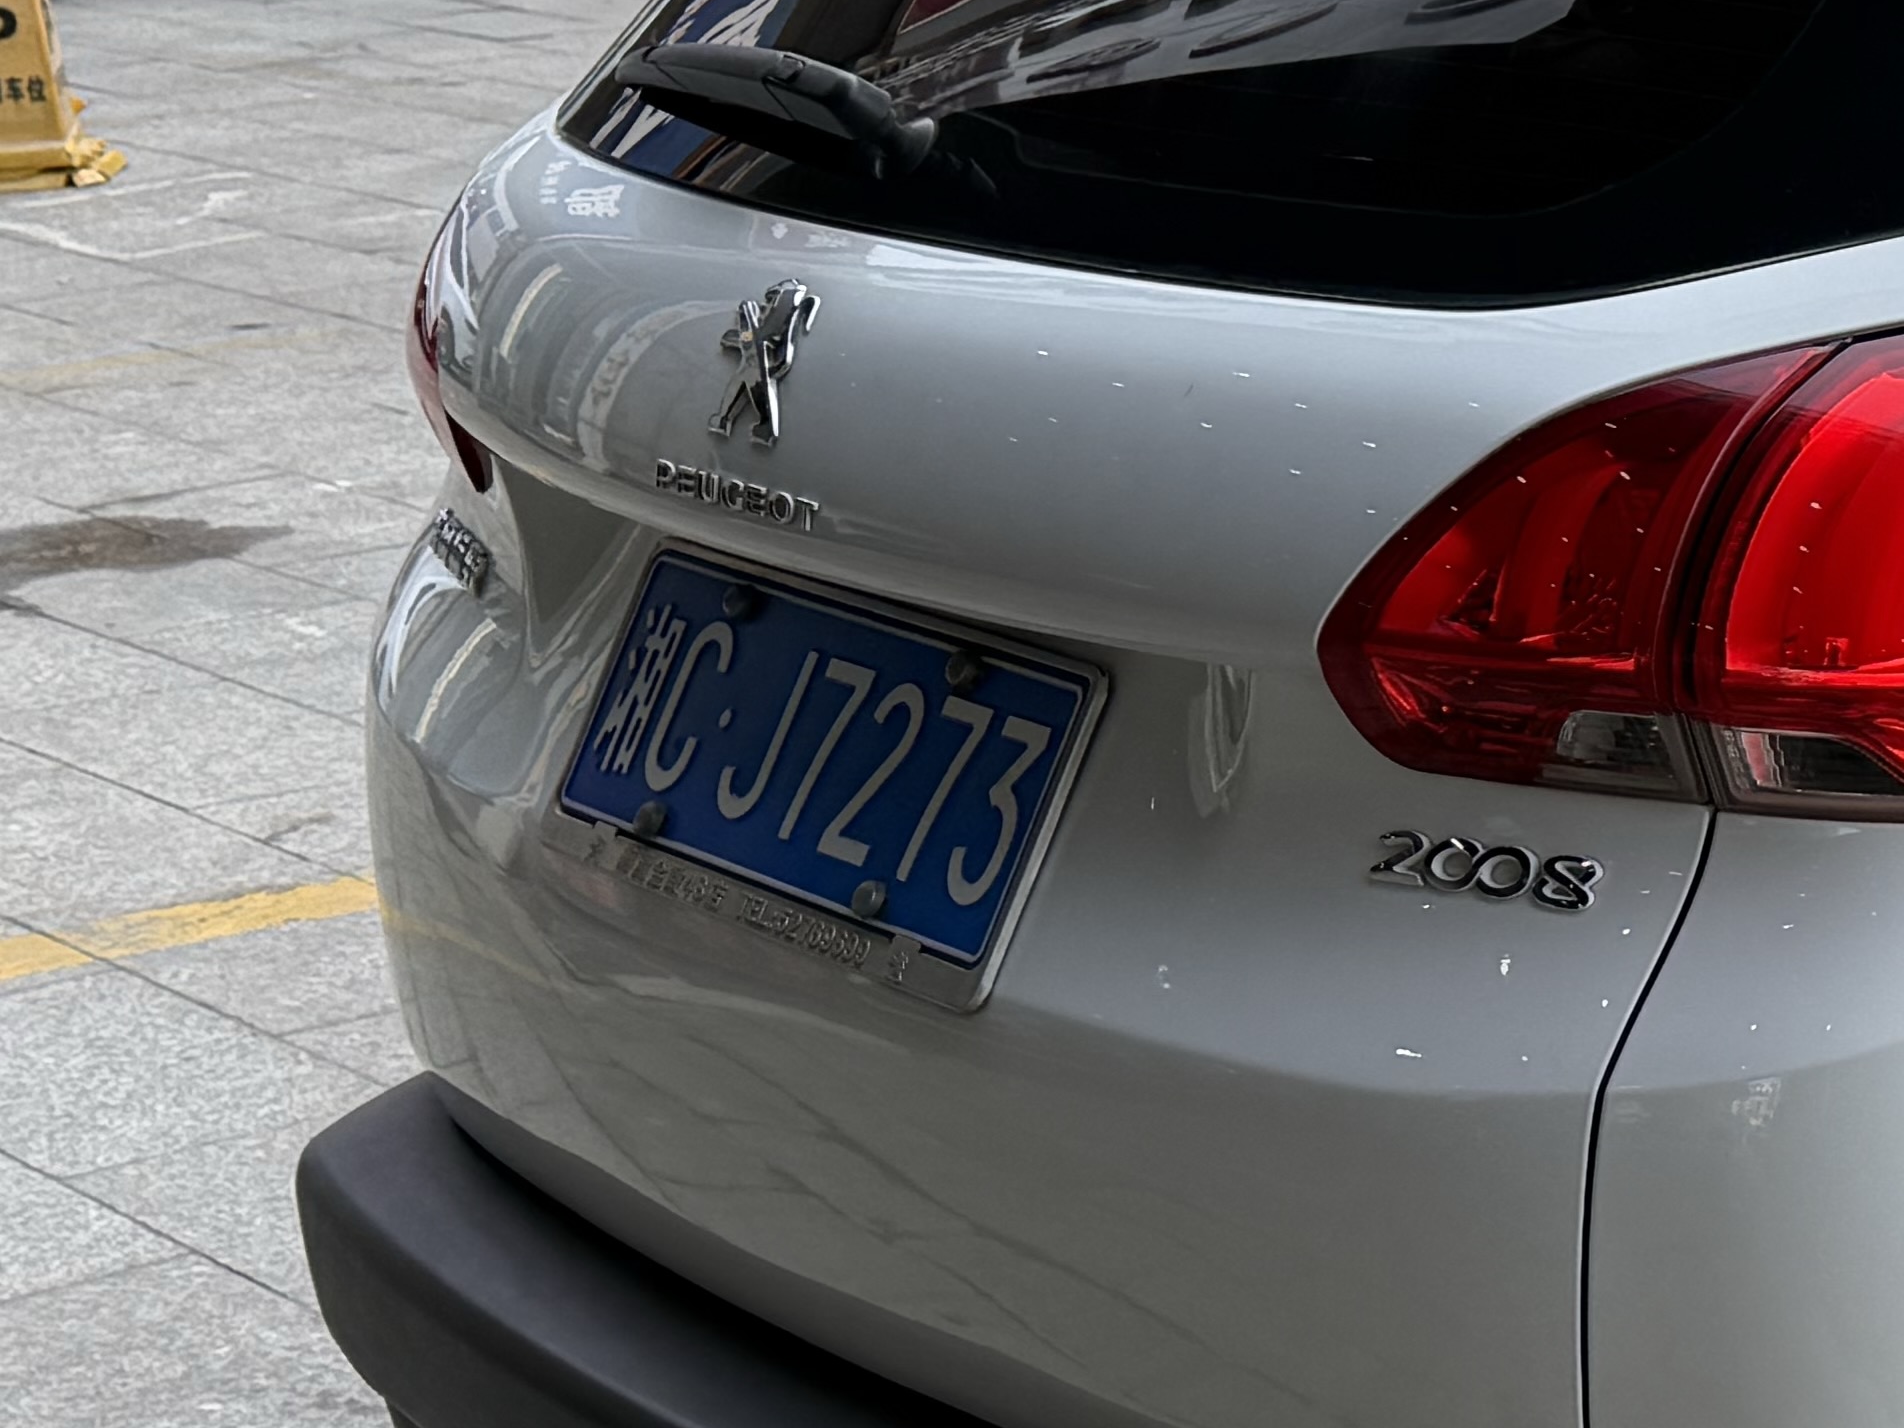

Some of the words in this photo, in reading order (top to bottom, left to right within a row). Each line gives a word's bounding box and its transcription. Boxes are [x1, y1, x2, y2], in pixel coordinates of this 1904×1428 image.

[0, 75, 47, 103] 车位
[655, 458, 820, 533] PEUGEOT
[1369, 829, 1606, 912] 2008
